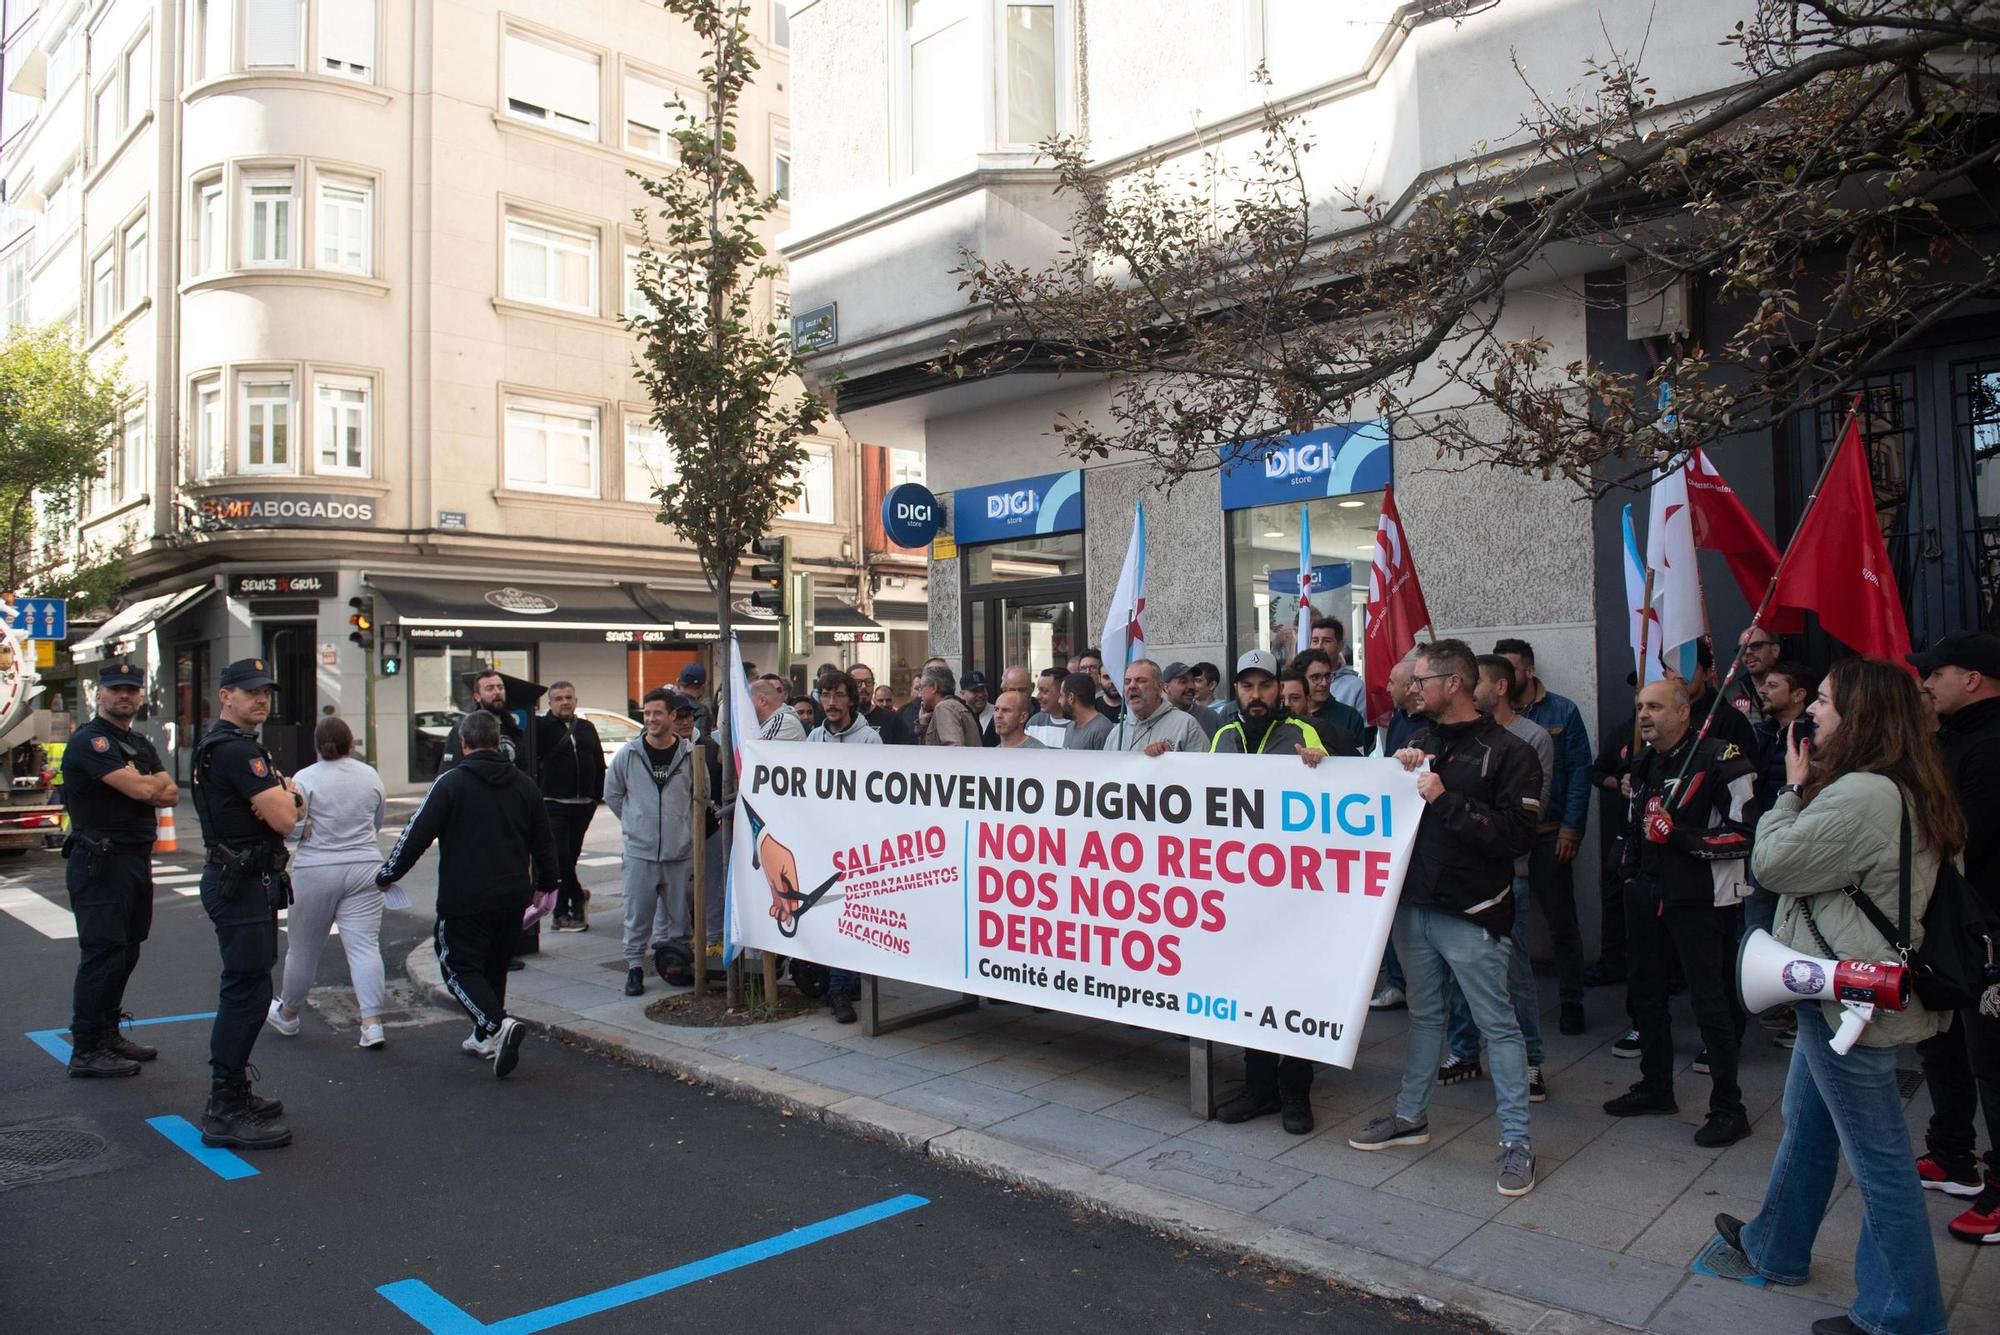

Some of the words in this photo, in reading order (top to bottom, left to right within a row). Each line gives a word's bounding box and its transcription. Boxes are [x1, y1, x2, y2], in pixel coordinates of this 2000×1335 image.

[1265, 442, 1330, 478] DIGI
[1290, 475, 1313, 486] store
[897, 503, 932, 521] DIGI
[987, 489, 1034, 518] DIGI
[1006, 517, 1023, 525] store
[906, 520, 923, 528] store
[290, 577, 322, 590] GRILL
[752, 765, 807, 798] POR
[815, 768, 856, 801] UN
[865, 770, 1044, 814] CONVENIO
[1054, 779, 1192, 824] DIGNO
[1205, 786, 1264, 829] EN
[1281, 790, 1393, 837] DIGI
[832, 825, 946, 883] SALARIO
[978, 822, 1067, 867] NON
[1078, 830, 1144, 873] AO
[1158, 834, 1392, 898] RECORTE
[844, 866, 959, 901] DESPRAZAMENTOS
[978, 866, 1059, 912] DOS
[1070, 875, 1227, 932] NOSOS
[843, 902, 908, 930] XORNADA
[837, 917, 911, 956] VACACIÓNS
[978, 910, 1182, 976] DEREITOS
[978, 958, 1048, 988] Comité
[1053, 970, 1078, 993] de
[1084, 975, 1181, 1012] Empresa
[1186, 991, 1237, 1022] DIGI
[1259, 1005, 1279, 1029] A
